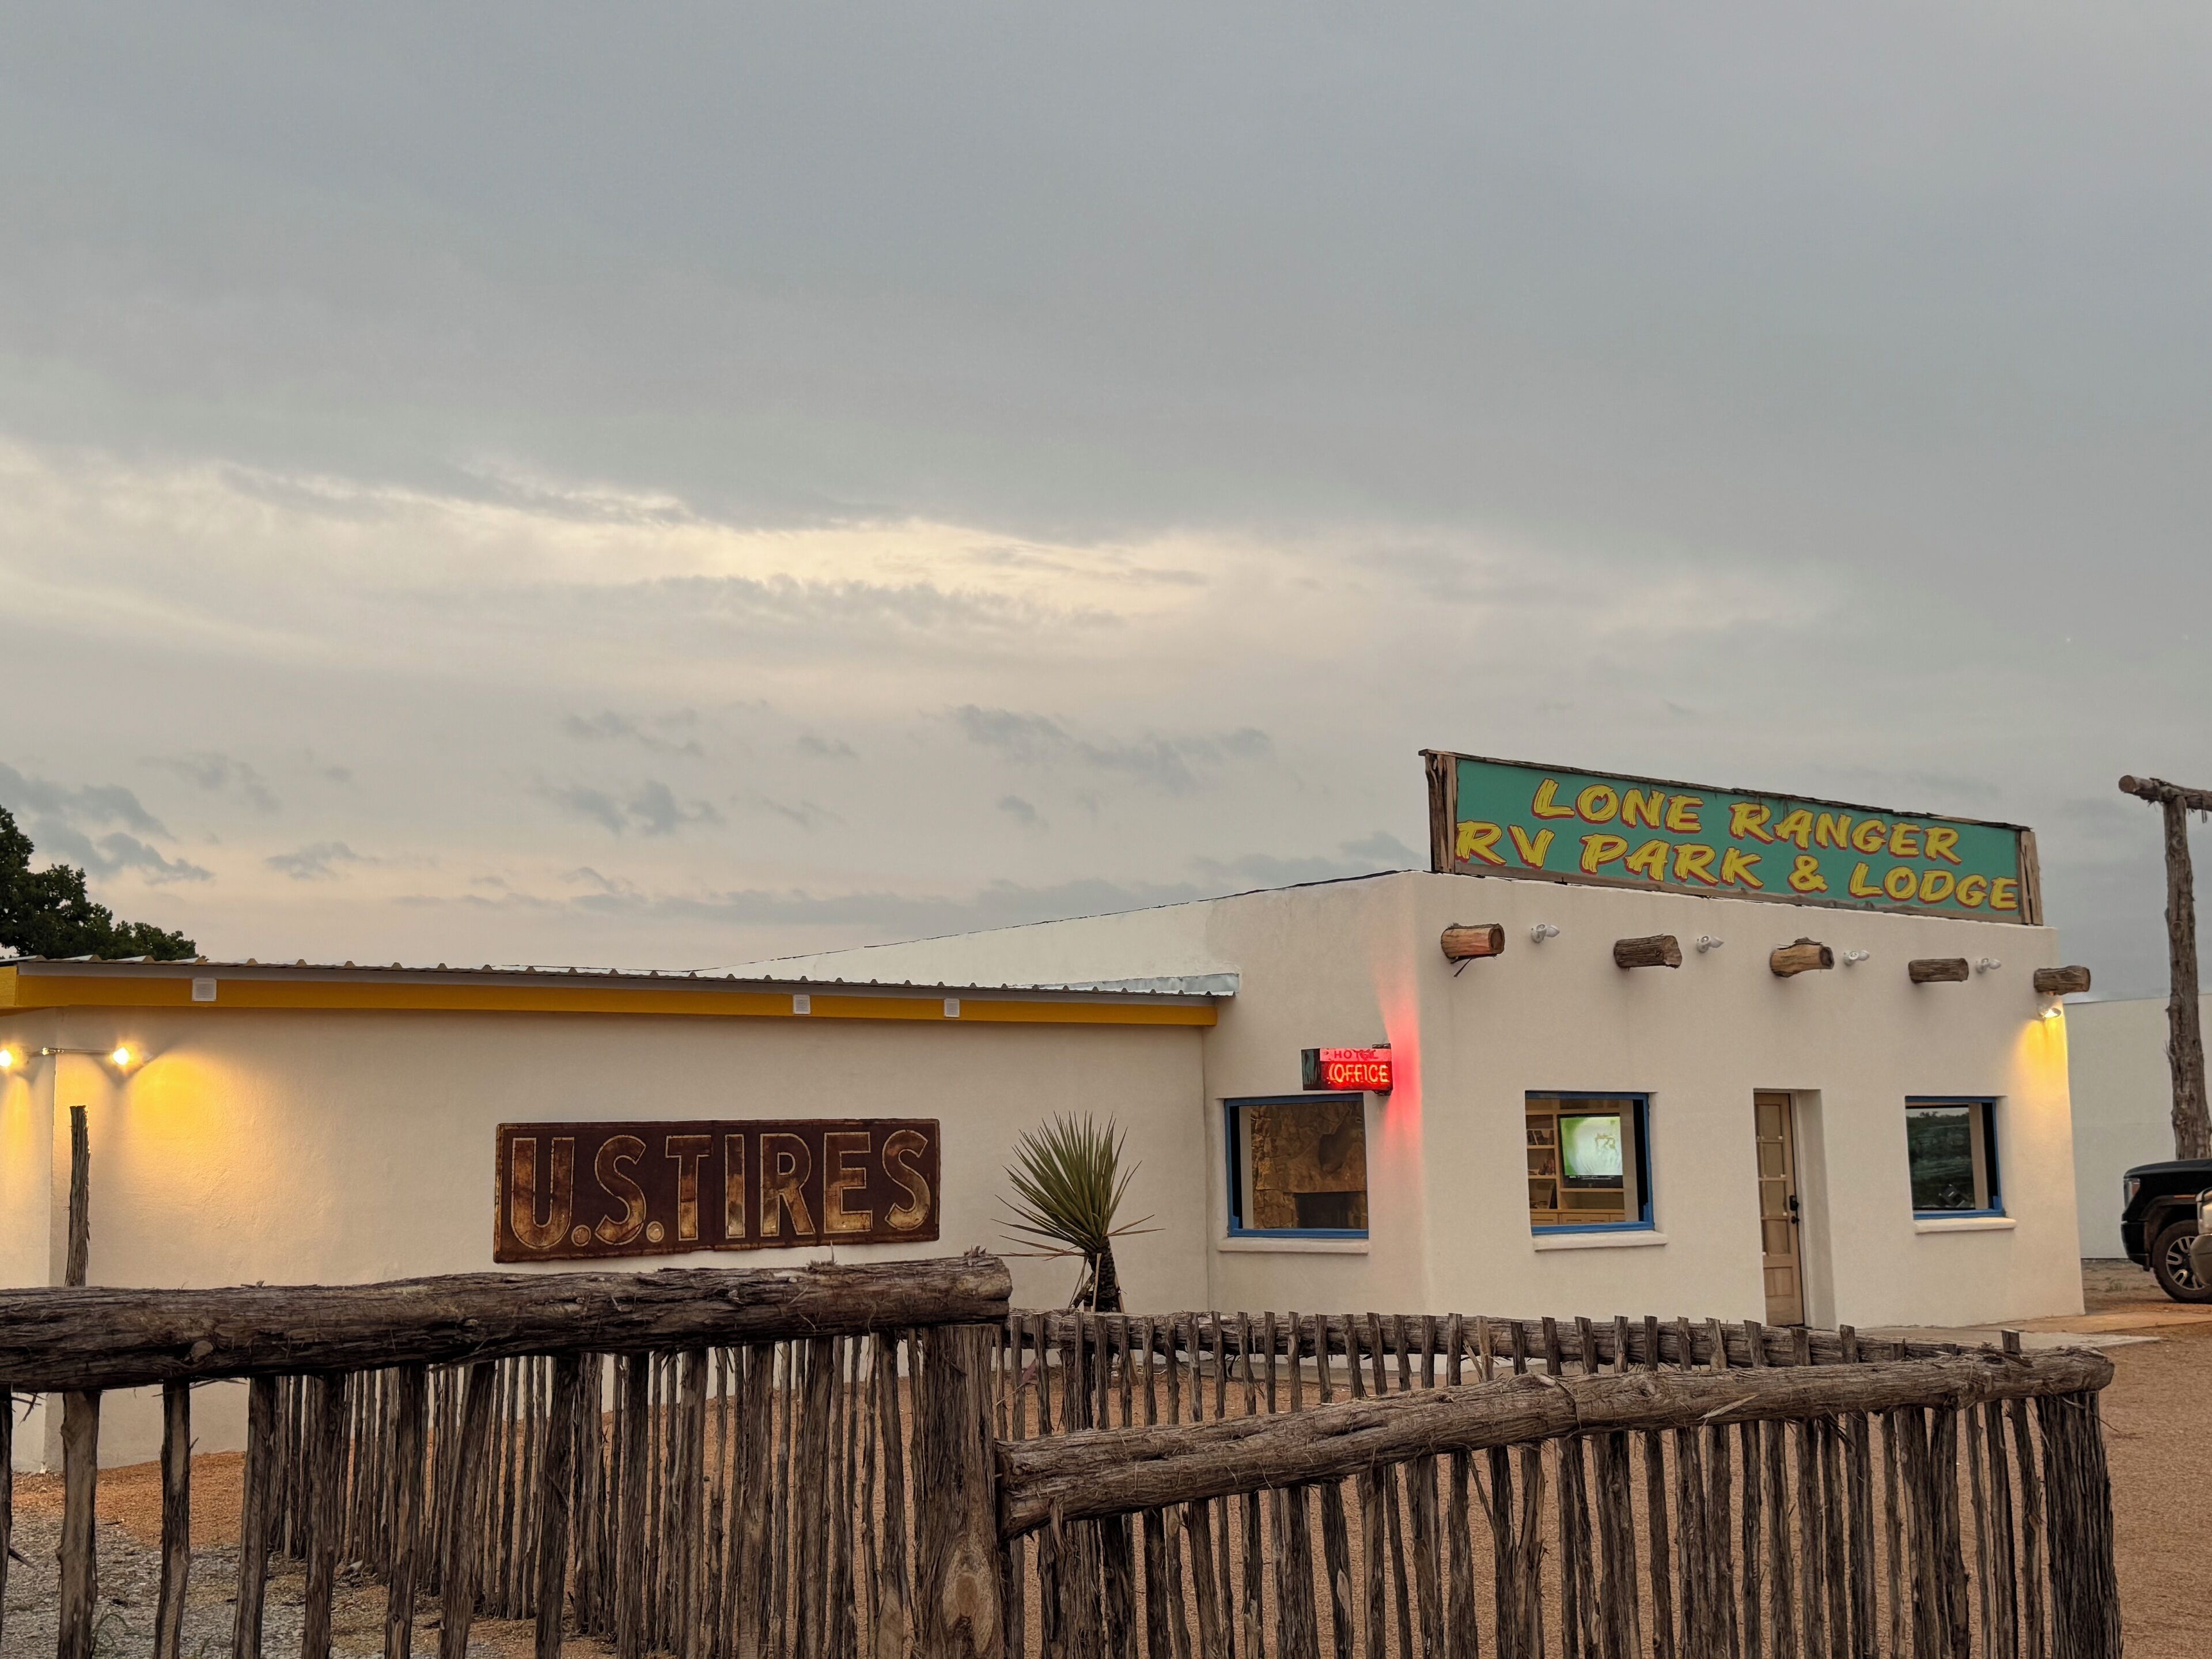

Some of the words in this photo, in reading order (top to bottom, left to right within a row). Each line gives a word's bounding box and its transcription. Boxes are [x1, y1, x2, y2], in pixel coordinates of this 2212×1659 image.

[1455, 820, 1555, 869] RV
[1579, 834, 1764, 888] PARK
[1788, 854, 1828, 893] &
[1849, 862, 2018, 910] LODGE
[1532, 778, 1704, 834] LONE
[1729, 801, 1962, 865] RANGER
